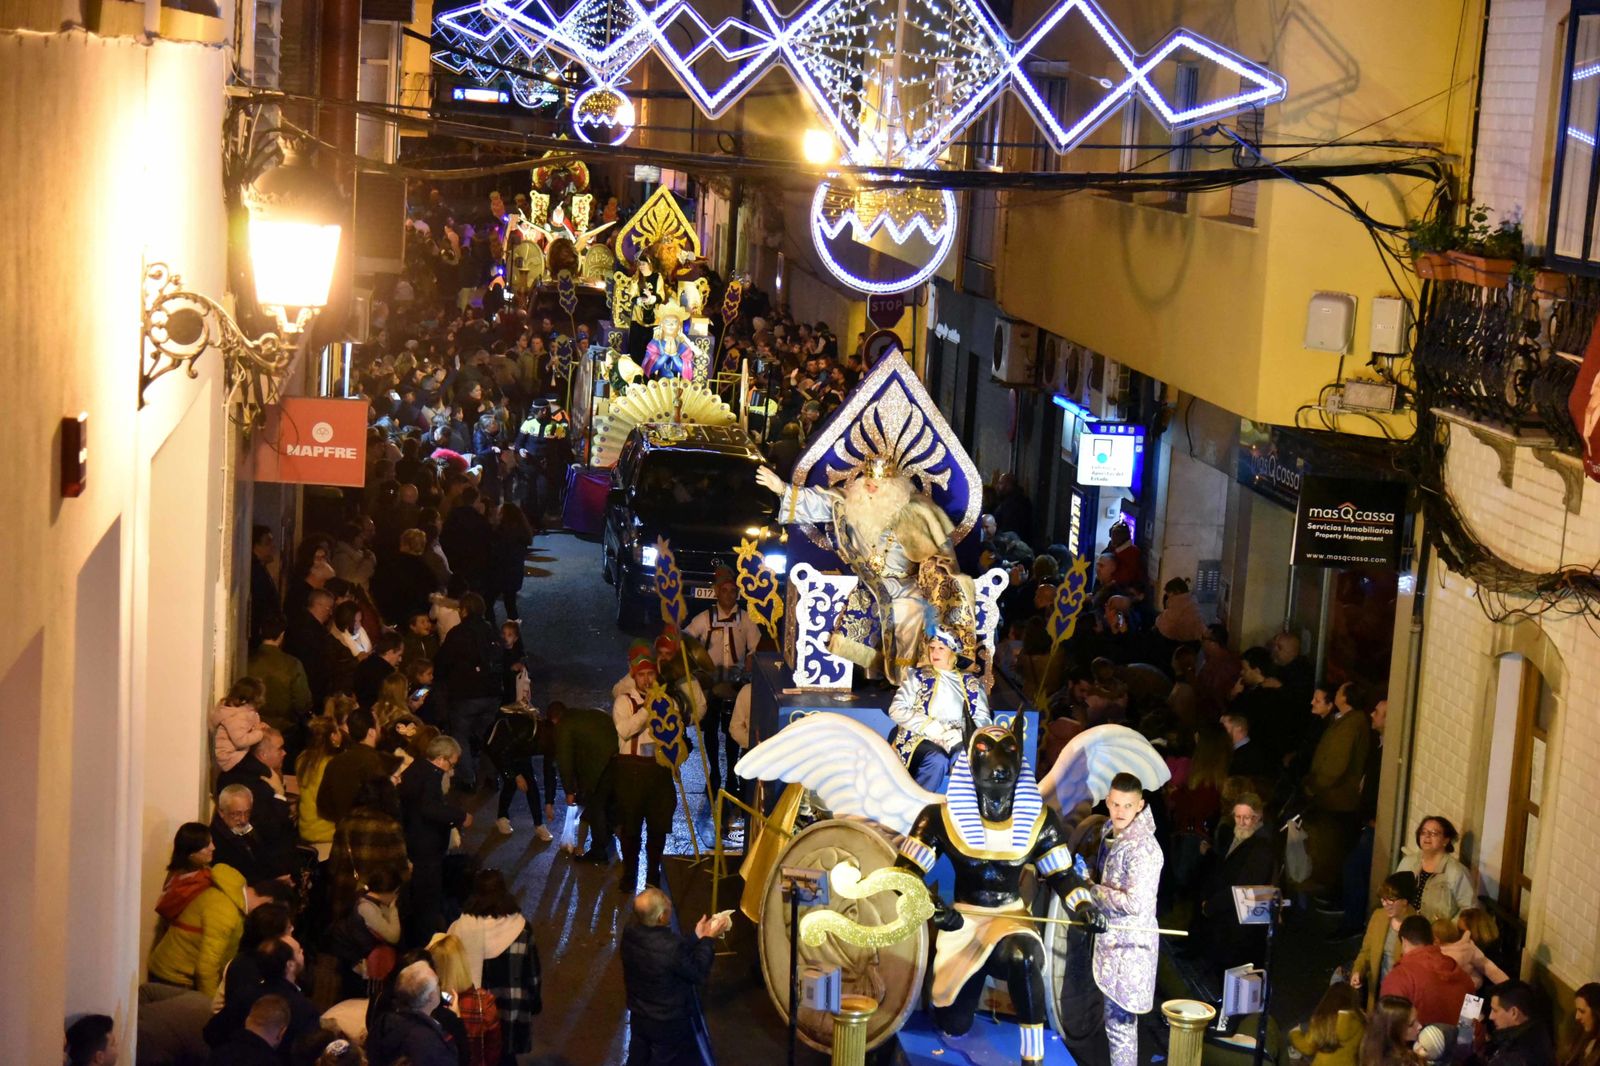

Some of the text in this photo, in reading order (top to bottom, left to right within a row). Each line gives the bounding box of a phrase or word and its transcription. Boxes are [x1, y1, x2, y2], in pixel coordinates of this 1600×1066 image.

[871, 300, 902, 312] STOP
[286, 444, 357, 459] MAPFRE
[1307, 522, 1393, 535] Servicios Inmobiliarios
[1315, 532, 1384, 542] Property Management
[1306, 552, 1387, 564] www.masqcassa.com
